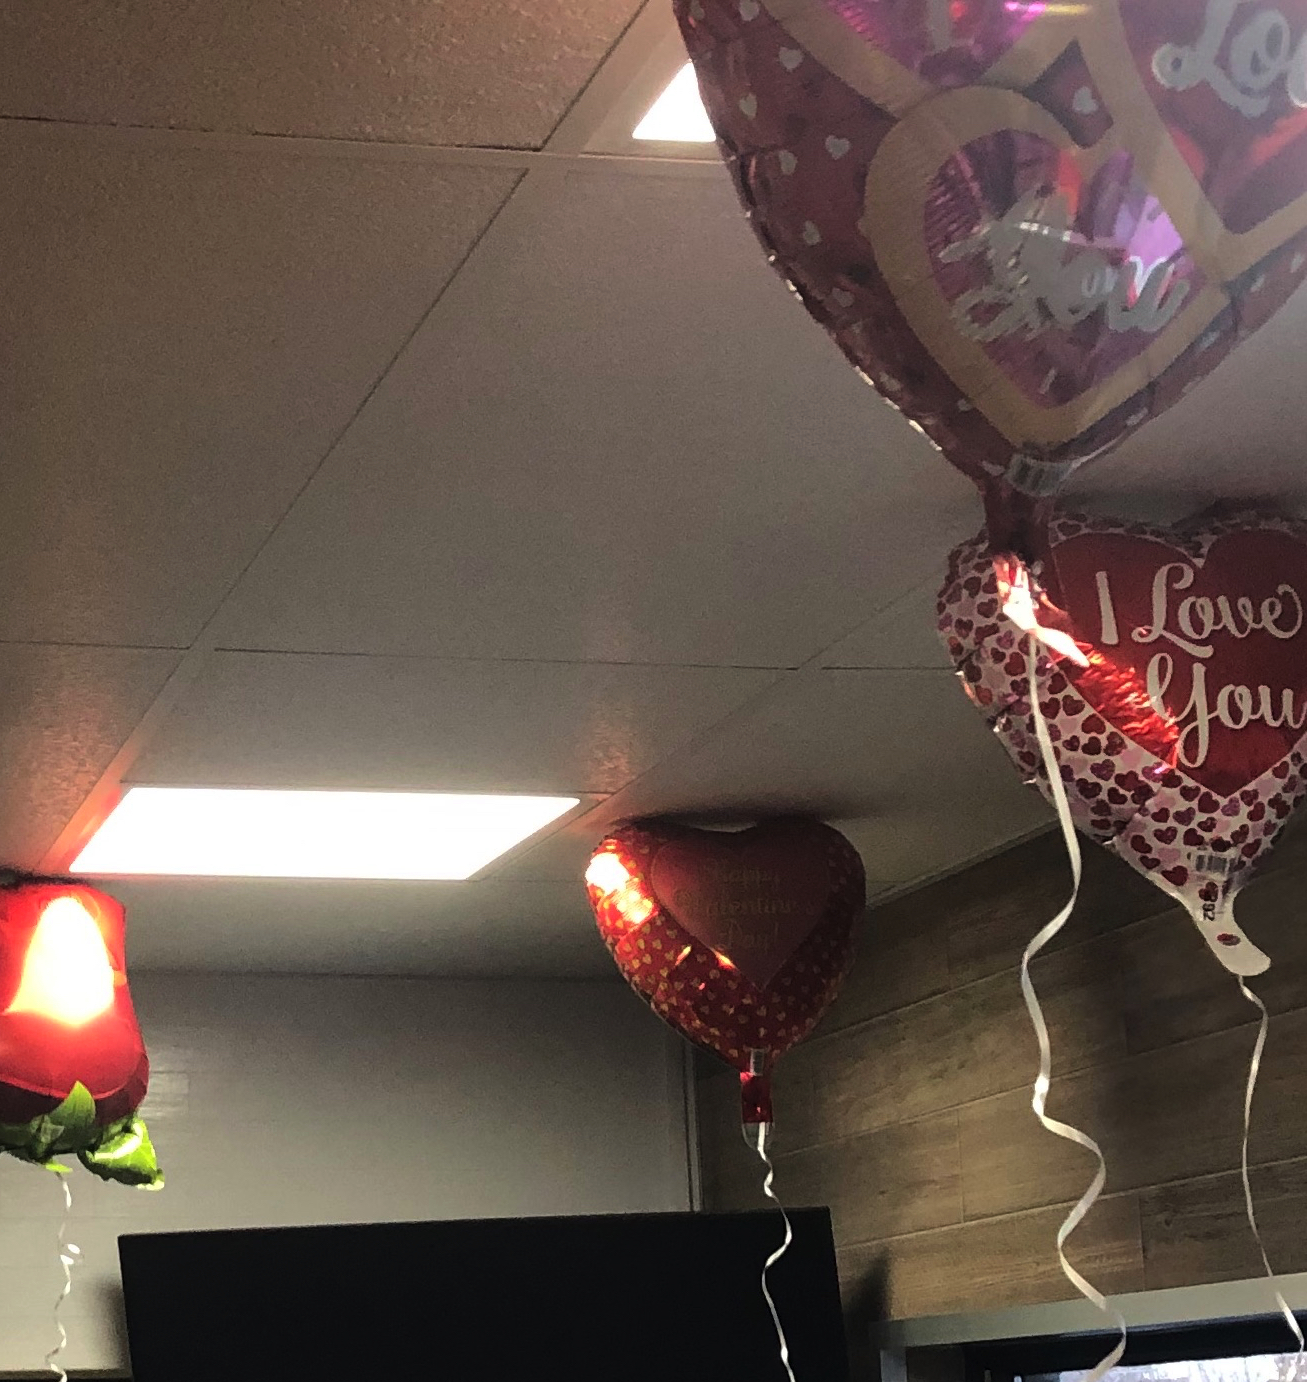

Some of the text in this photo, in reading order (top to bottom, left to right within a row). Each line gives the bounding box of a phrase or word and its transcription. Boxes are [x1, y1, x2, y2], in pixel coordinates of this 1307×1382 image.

[1096, 562, 1303, 658] I Love
[1146, 652, 1307, 768] You
